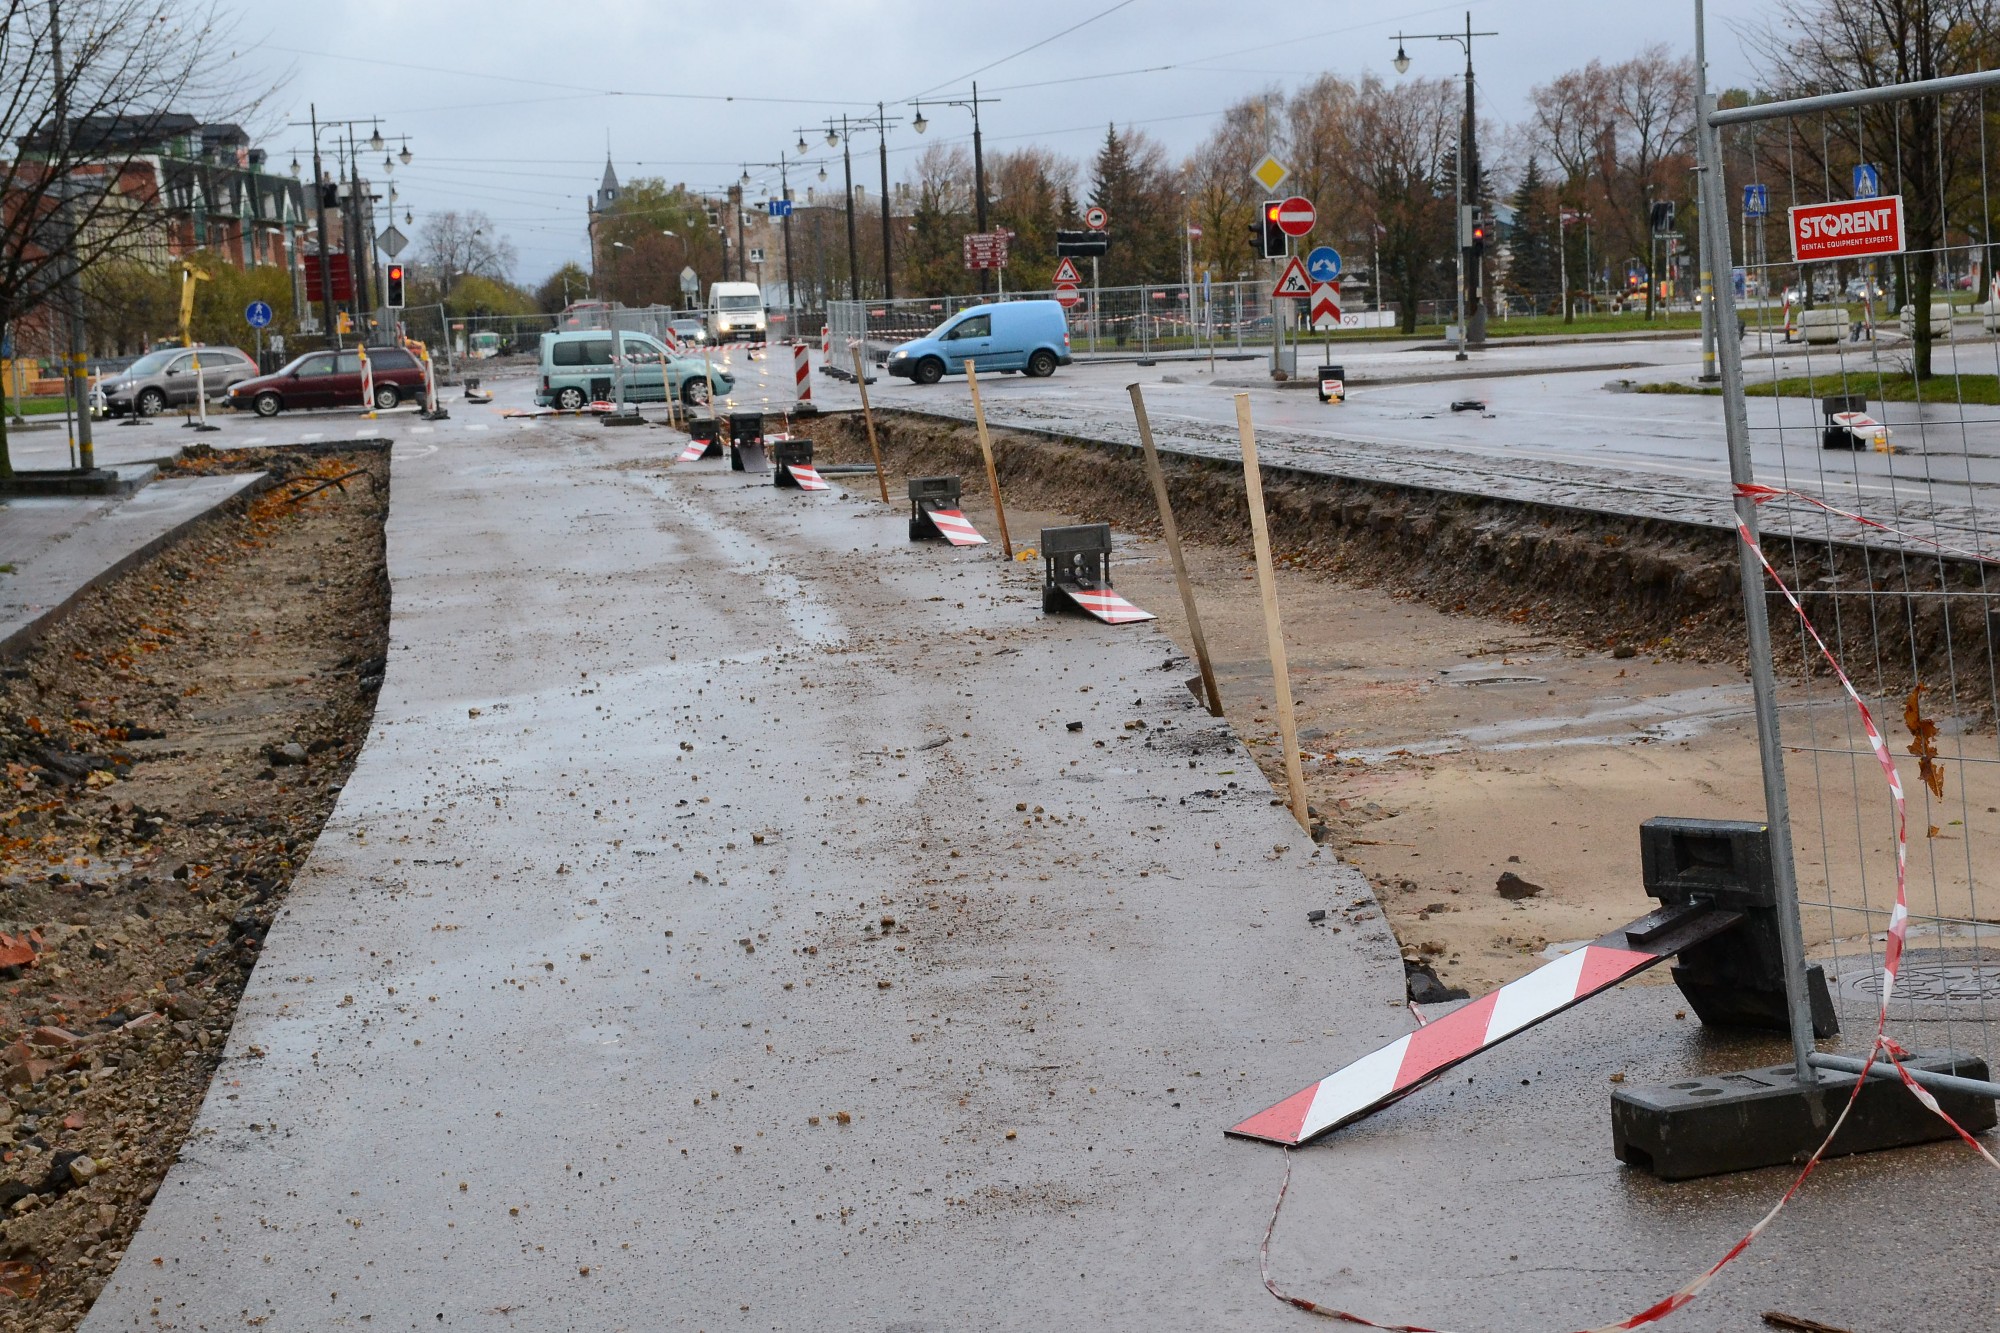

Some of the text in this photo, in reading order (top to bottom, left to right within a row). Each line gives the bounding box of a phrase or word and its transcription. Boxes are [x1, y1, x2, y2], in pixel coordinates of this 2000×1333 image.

[1799, 208, 1891, 238] STORENT
[1801, 235, 1893, 251] RENTAL EQUIPMENT EXPERTS
